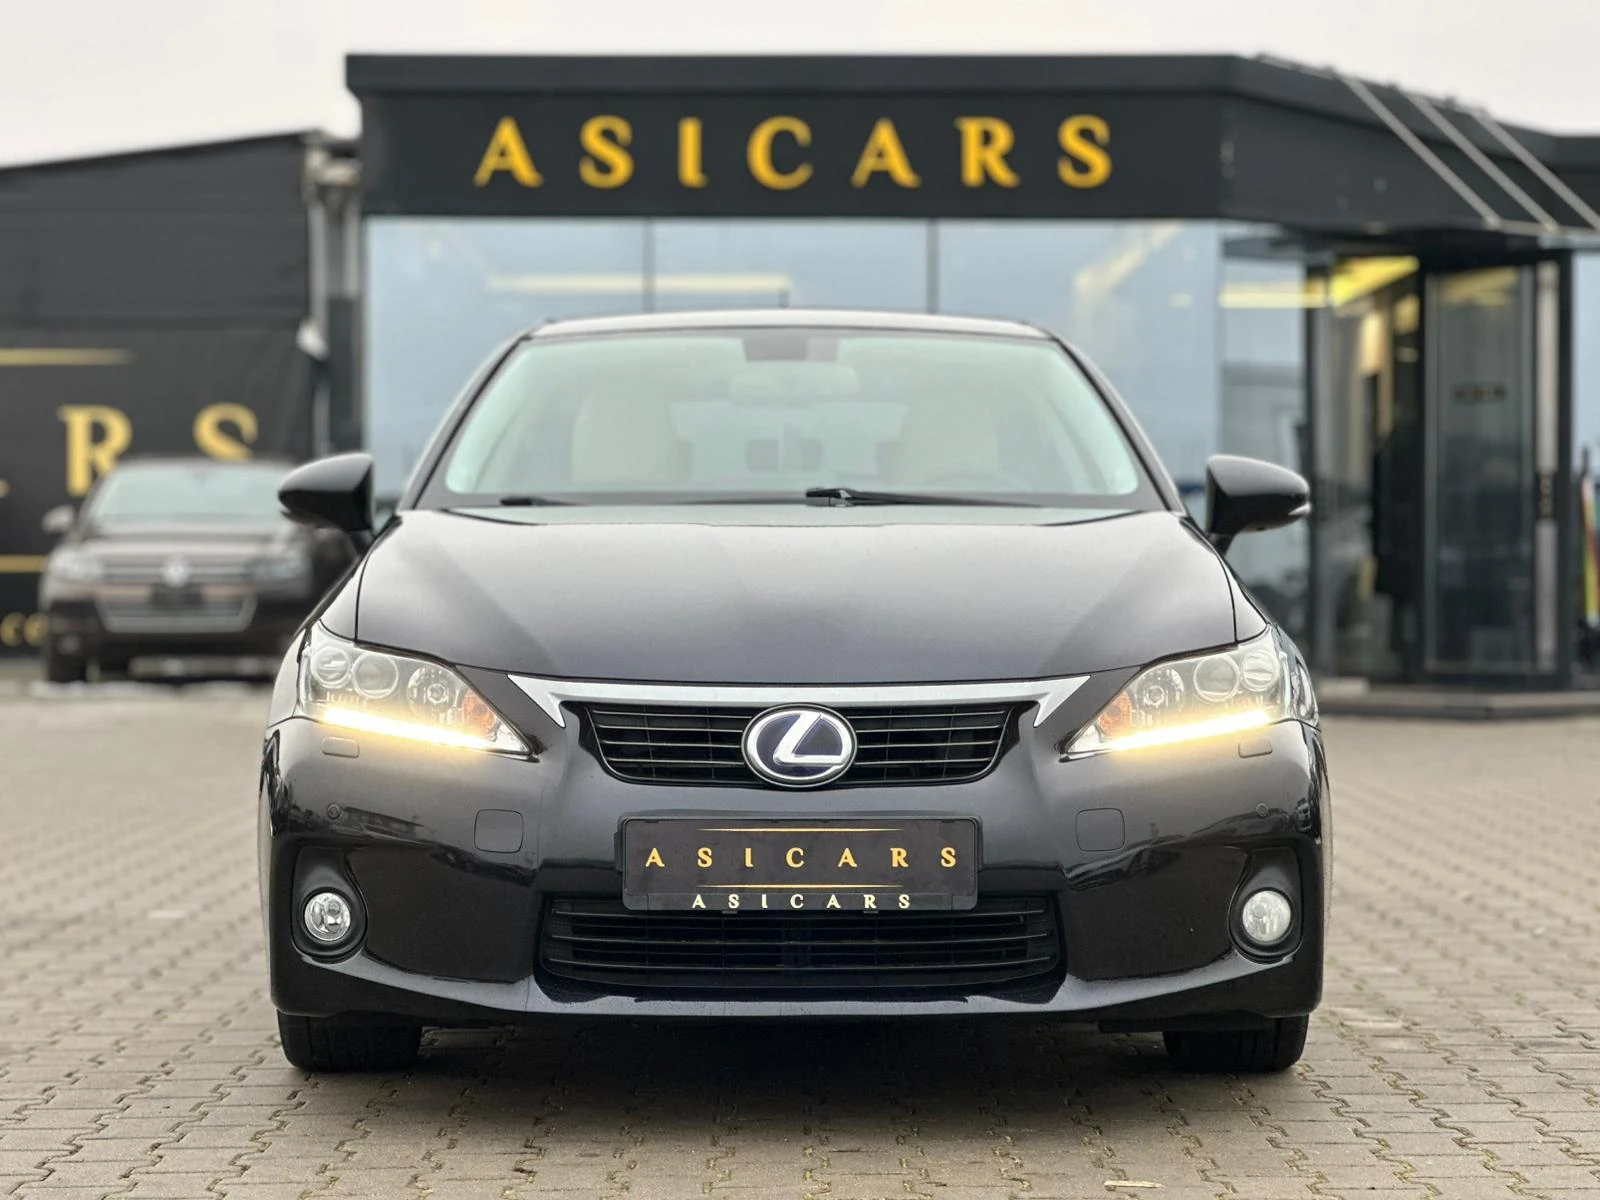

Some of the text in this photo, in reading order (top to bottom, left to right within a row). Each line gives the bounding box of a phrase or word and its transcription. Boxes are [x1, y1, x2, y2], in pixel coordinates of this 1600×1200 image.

[474, 115, 1113, 190] ASICARS
[0, 404, 259, 498] RS
[645, 846, 957, 869] ASICARS
[691, 892, 911, 910] ASICARS
